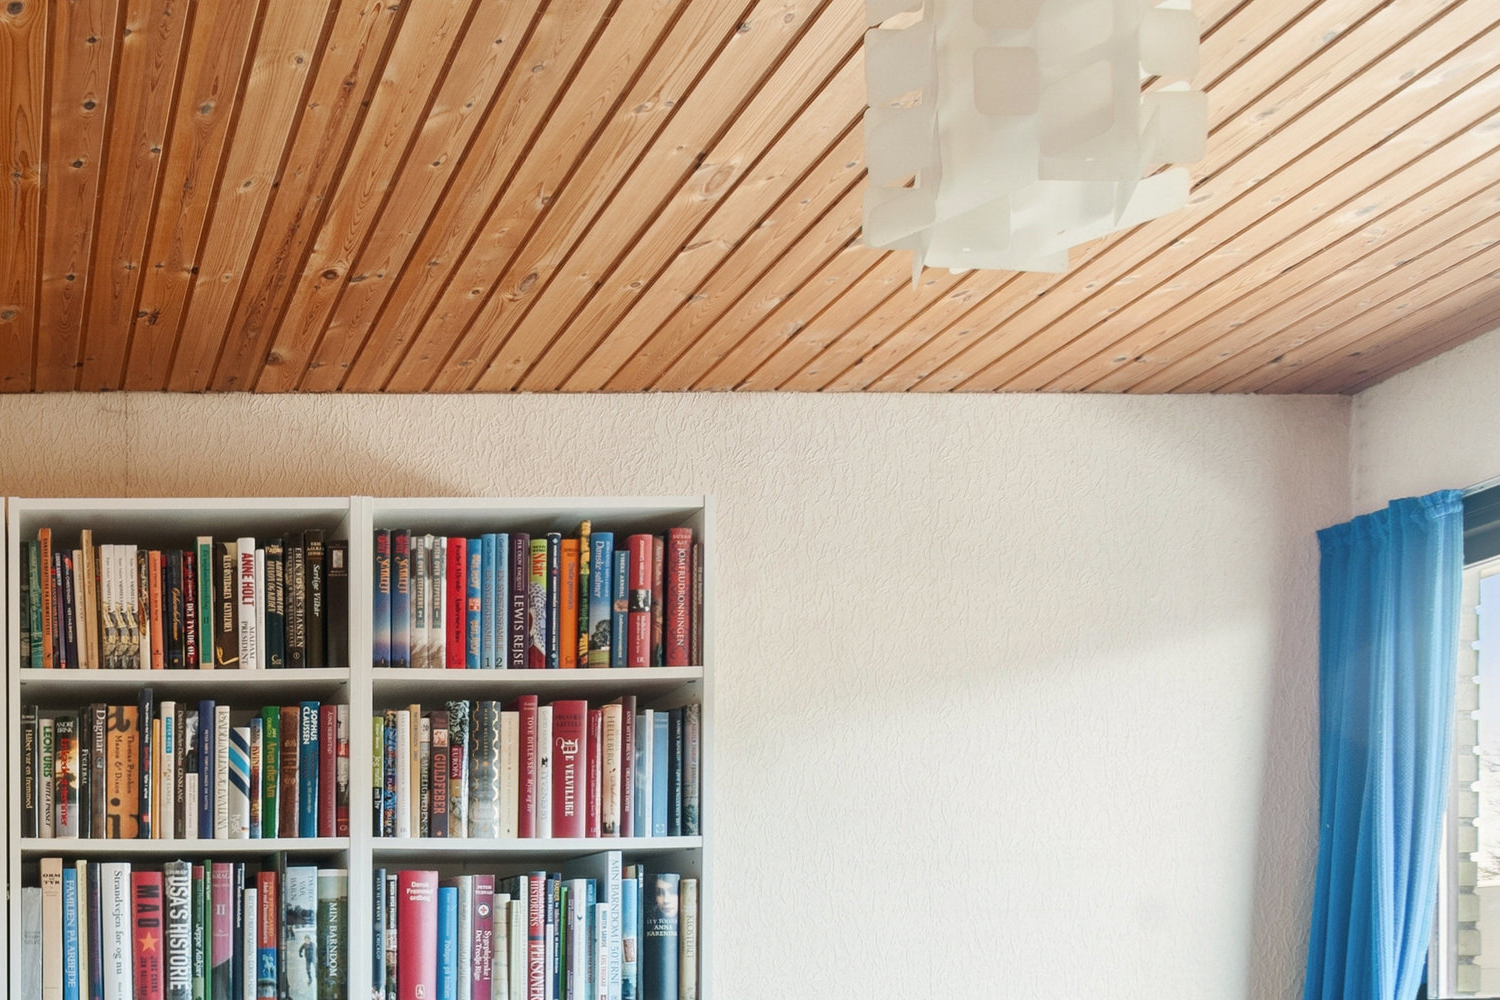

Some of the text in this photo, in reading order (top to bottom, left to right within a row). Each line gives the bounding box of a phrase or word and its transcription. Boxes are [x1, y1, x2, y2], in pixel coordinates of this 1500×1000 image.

[242, 553, 254, 606] ANNE HOLT
[594, 541, 604, 597] Danske salmer
[677, 548, 686, 646] JOMFRUDRONNINGEN
[512, 595, 524, 665] LEWIS REJSE
[43, 726, 52, 754] LEON
[94, 710, 106, 753] Dagmar
[302, 707, 310, 744] CLAUSSEN
[310, 710, 318, 741] SOPHUS
[25, 766, 32, 775] en
[43, 756, 52, 778] URIS
[115, 762, 122, 770] &
[434, 754, 446, 814] GULDFEBER
[25, 777, 33, 808] fremmed
[565, 764, 574, 817] VELVILLIGE
[112, 871, 122, 927] Strandvejen
[137, 885, 159, 928] MAO
[530, 880, 539, 926] HISTORIENS
[66, 880, 76, 988] FAMILIEN PÅ ARBEJDE
[113, 948, 123, 959] og
[169, 877, 190, 990] USA'S HISTORIE
[116, 962, 123, 974] nu
